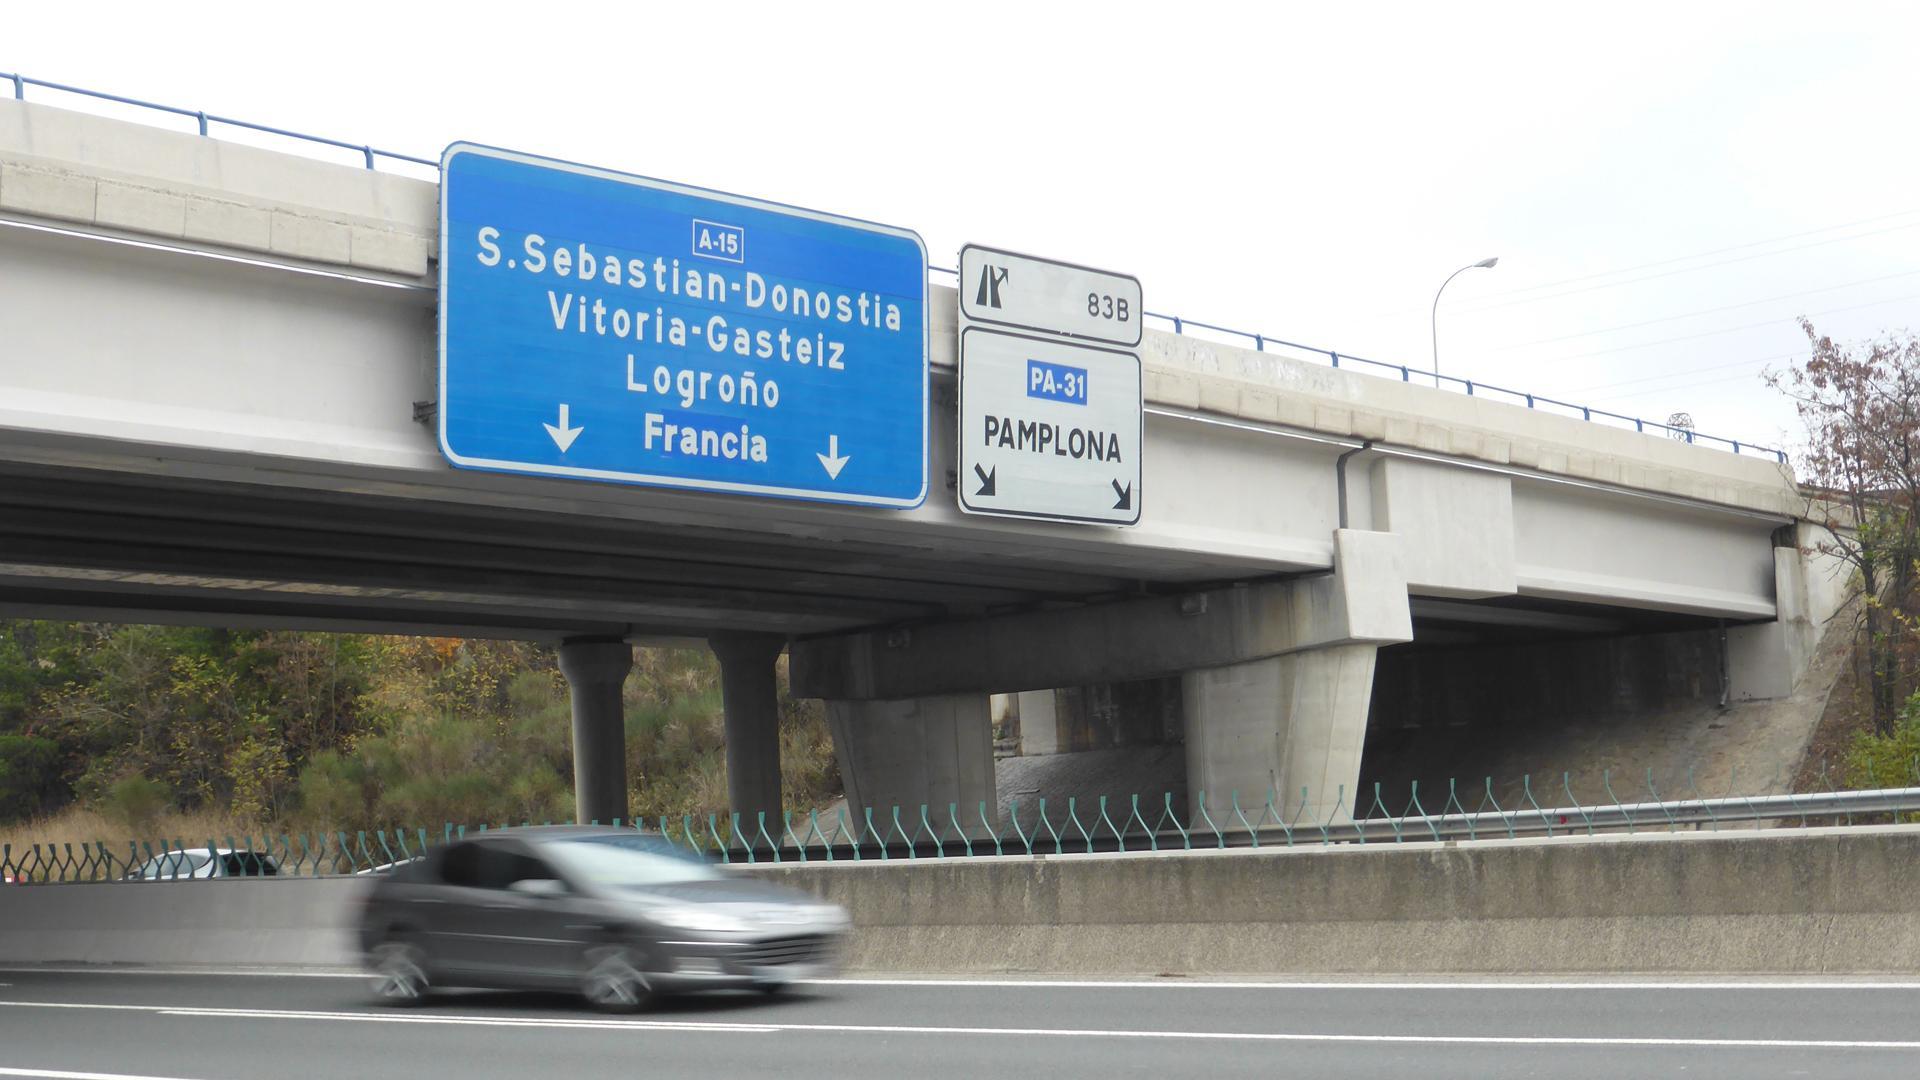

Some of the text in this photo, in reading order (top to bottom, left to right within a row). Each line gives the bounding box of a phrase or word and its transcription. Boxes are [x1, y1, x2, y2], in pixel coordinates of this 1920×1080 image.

[699, 228, 739, 255] A-15
[547, 290, 846, 370] Vitoria-Gasteiz
[1086, 292, 1130, 322] 83B
[626, 354, 780, 409] Logroño
[1031, 367, 1085, 399] PA-31
[644, 413, 769, 463] Francia
[984, 415, 1122, 464] PAMPLONA
